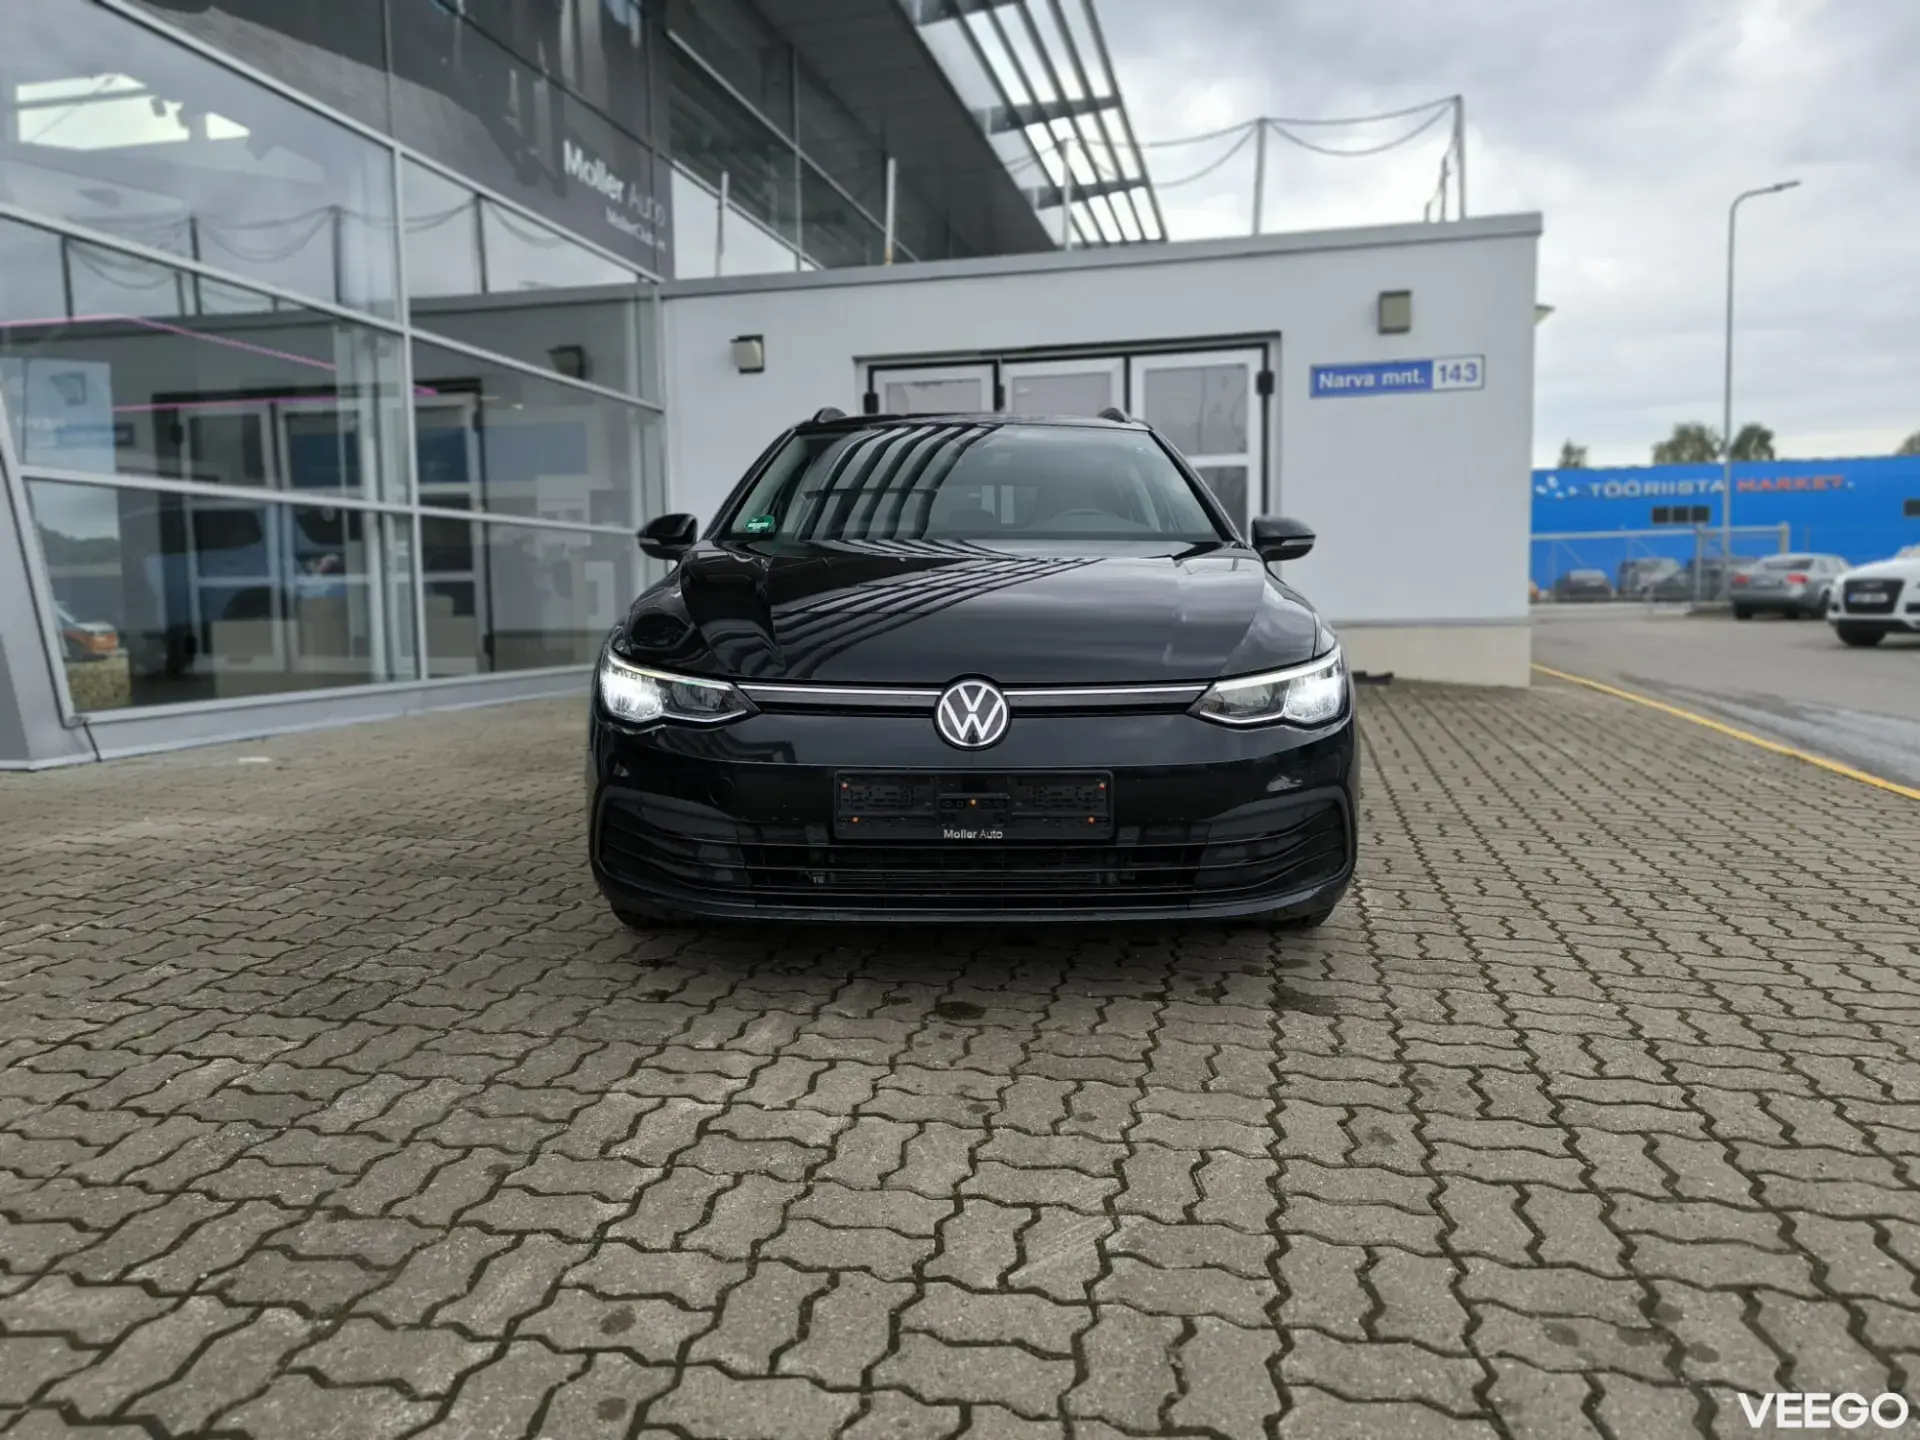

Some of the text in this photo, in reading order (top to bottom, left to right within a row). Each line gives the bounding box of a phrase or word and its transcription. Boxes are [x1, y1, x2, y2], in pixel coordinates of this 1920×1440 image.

[1318, 361, 1478, 390] Narva mnt. 143
[1737, 475, 1844, 493] MARKET
[943, 829, 1003, 839] Moller Auto
